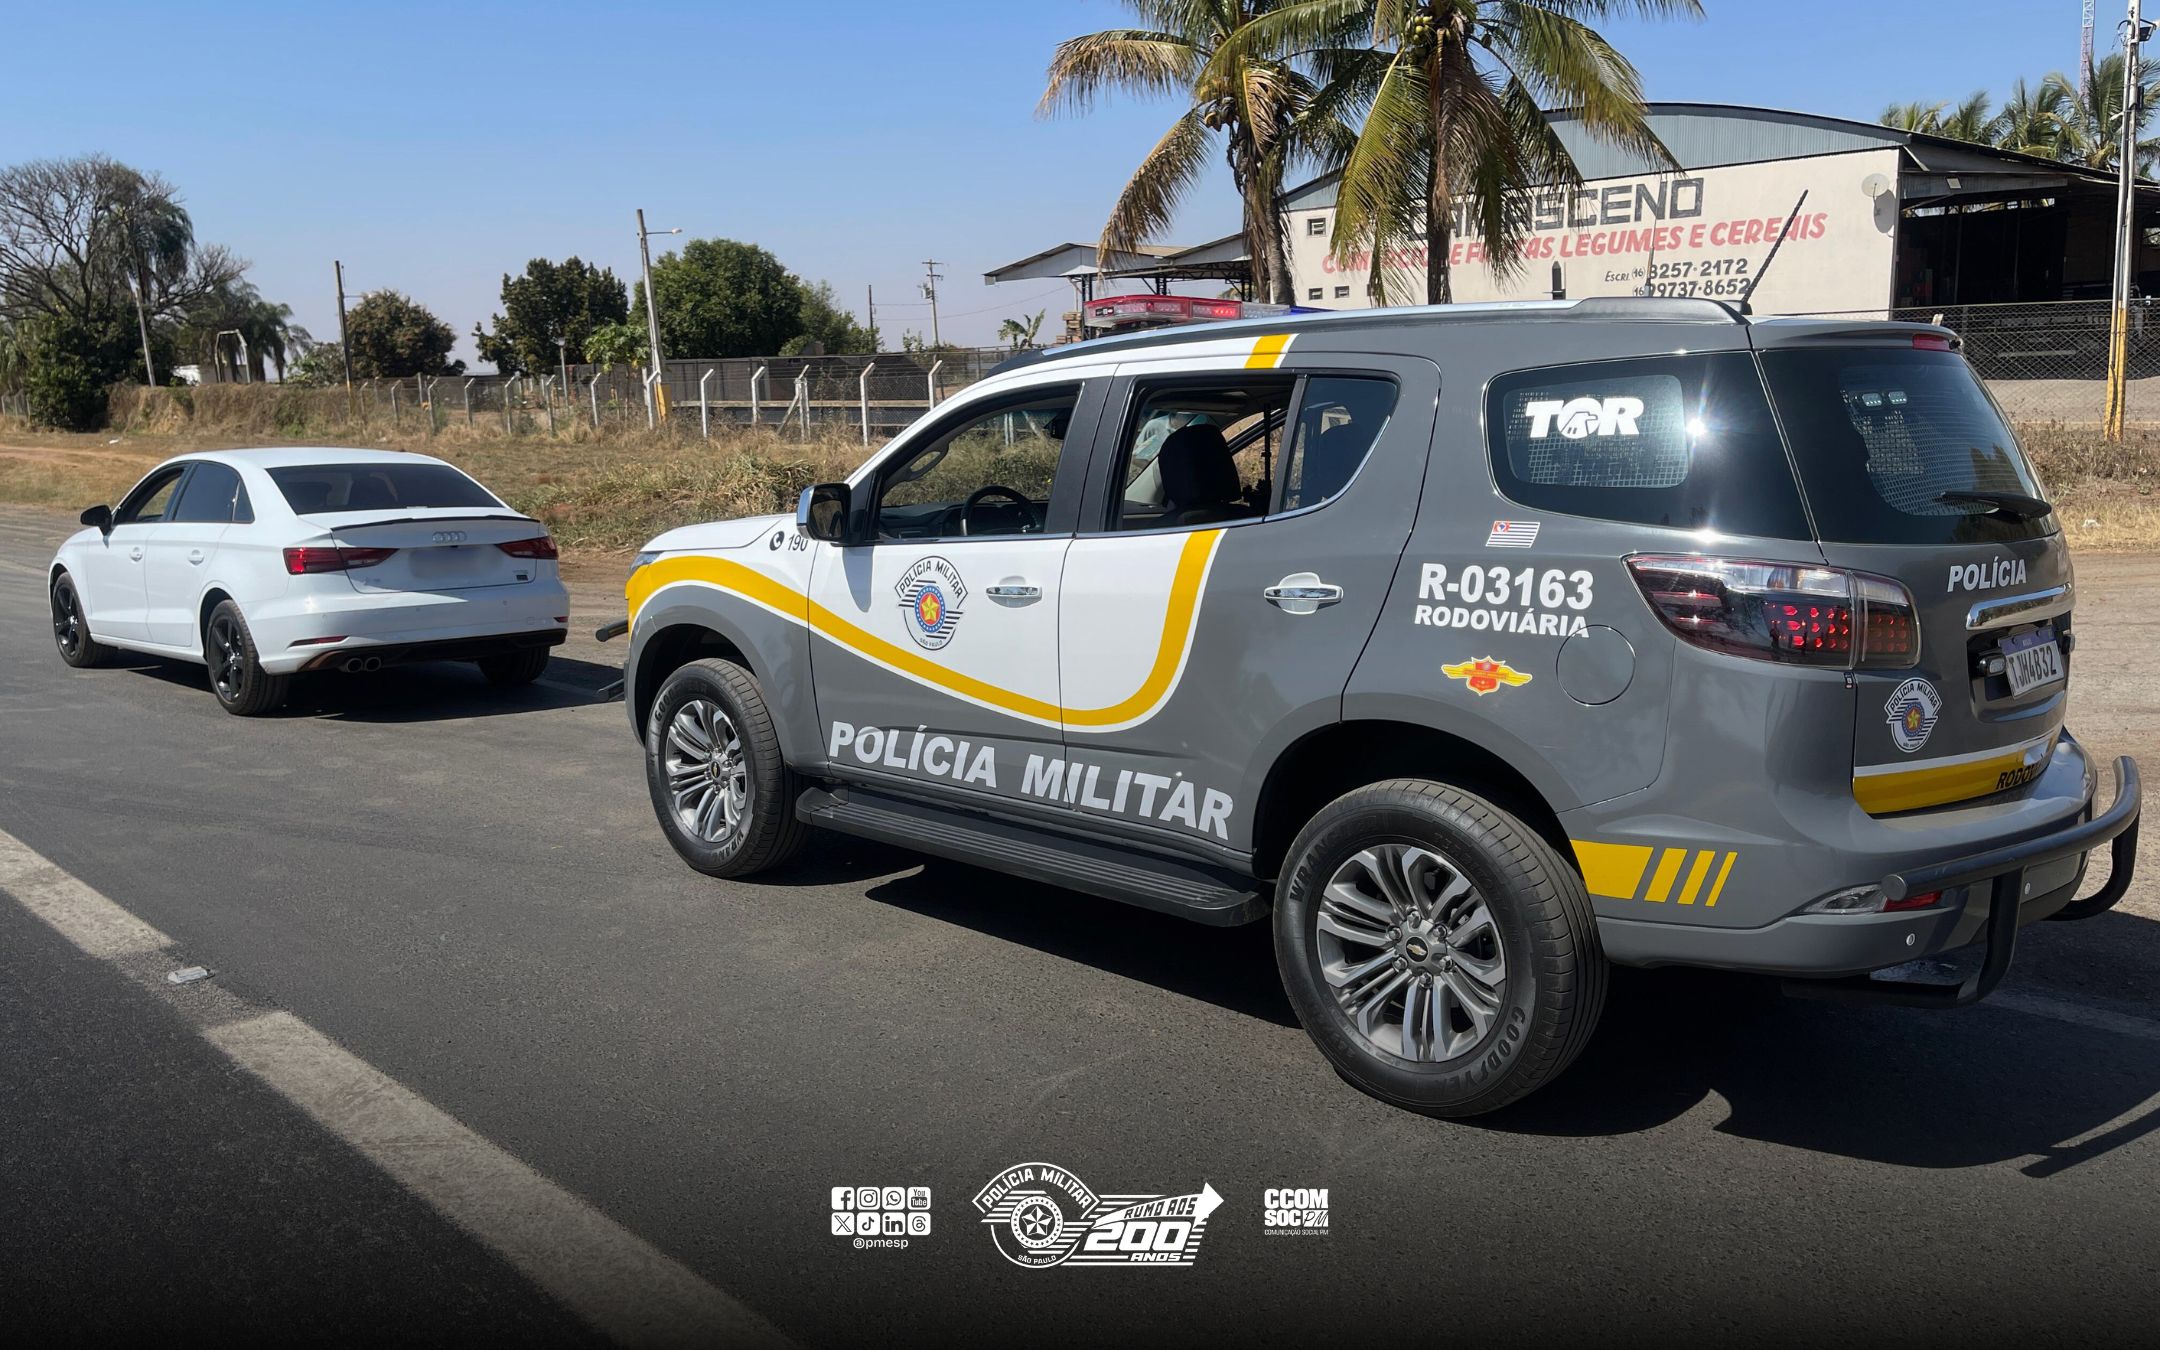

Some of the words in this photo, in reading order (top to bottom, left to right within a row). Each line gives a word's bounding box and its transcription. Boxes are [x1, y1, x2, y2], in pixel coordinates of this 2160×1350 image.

[1559, 225, 1685, 258] LEGUMES
[1688, 223, 1707, 249] E
[1709, 212, 1829, 246] CEREAIS
[1525, 397, 1644, 440] TOR
[787, 533, 809, 552] 190
[899, 560, 932, 594] POLÍCIA
[934, 560, 964, 599] MILITAR
[1418, 562, 1594, 610] R-03163
[1947, 555, 2027, 593] POLÍCIA
[1414, 605, 1590, 638] RODOVIÁRIA
[1889, 683, 1915, 712] POLÍCIA
[1916, 682, 1938, 709] MILITAR
[829, 720, 997, 788] POLÍCIA
[1020, 753, 1234, 841] MILITAR
